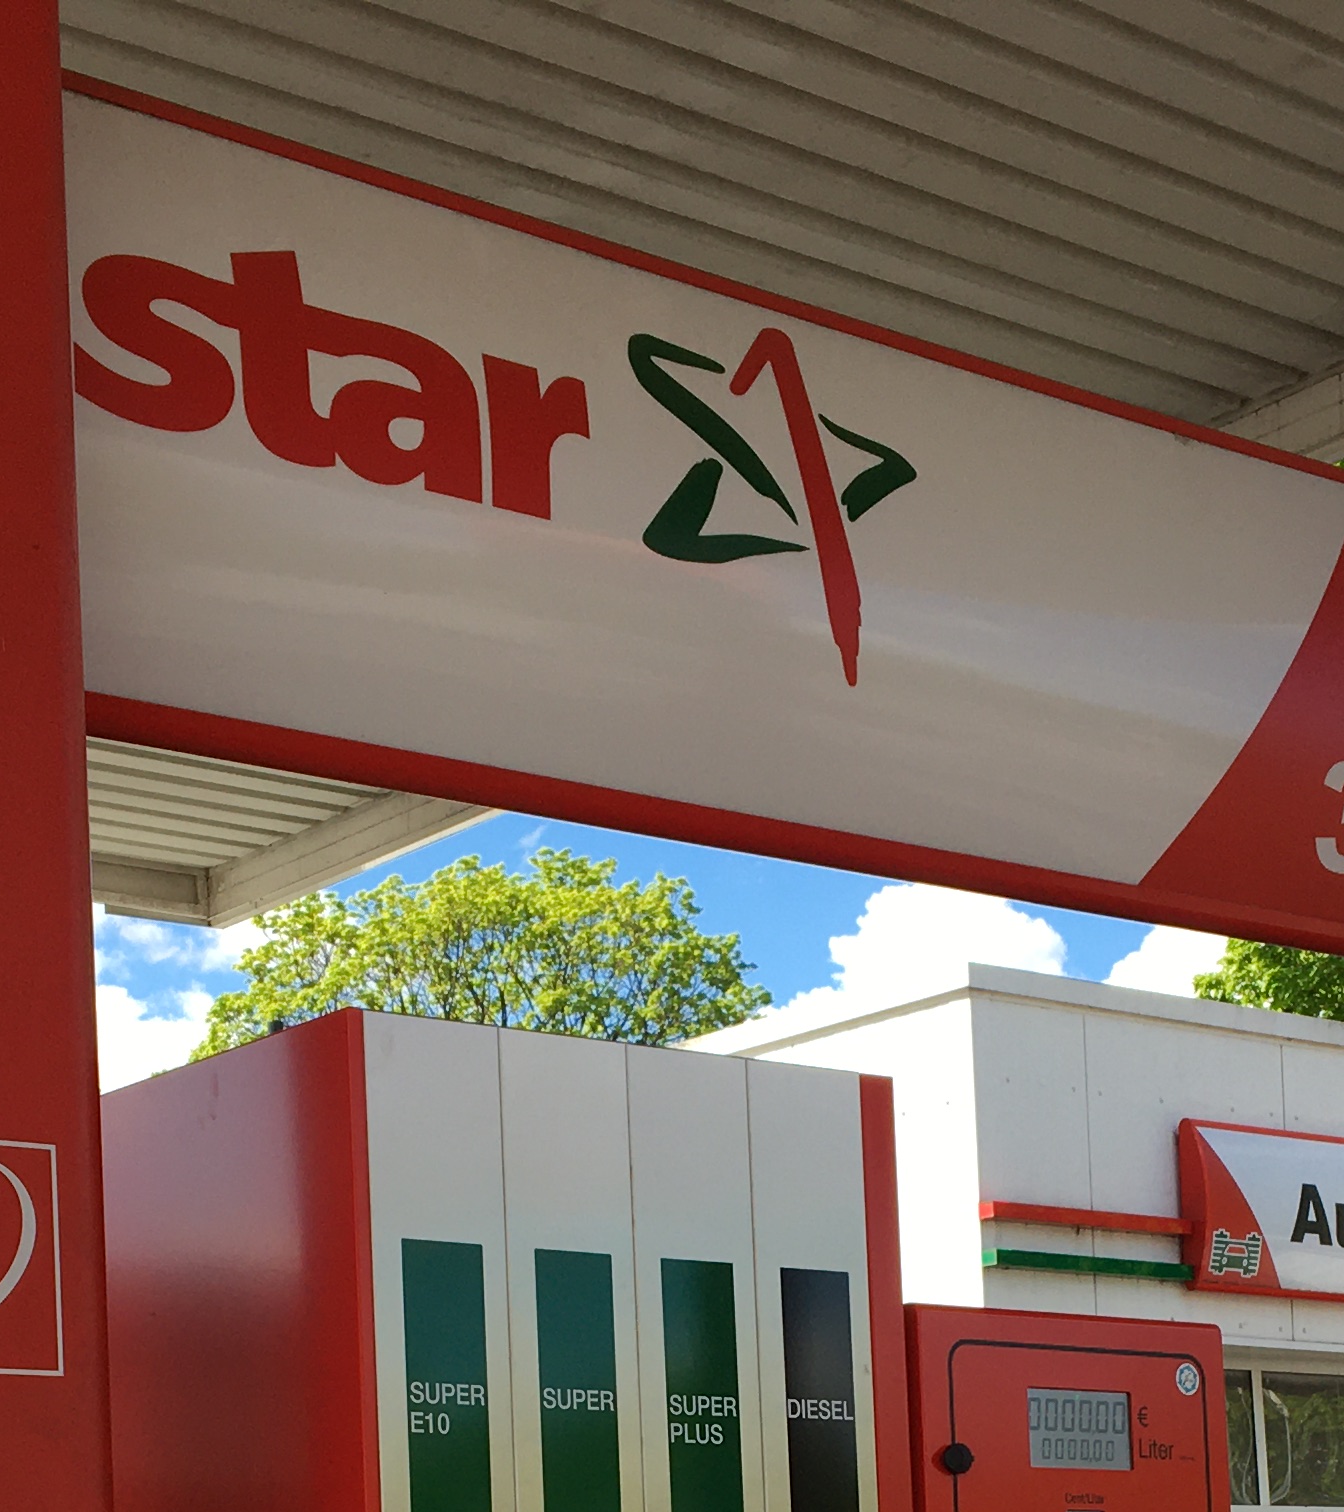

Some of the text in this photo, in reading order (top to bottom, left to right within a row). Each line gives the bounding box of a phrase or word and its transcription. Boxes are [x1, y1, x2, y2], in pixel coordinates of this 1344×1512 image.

[74, 249, 590, 520] star
[409, 1381, 486, 1407] SUPER
[542, 1387, 615, 1413] SUPER
[669, 1395, 738, 1419] SUPER
[787, 1398, 854, 1422] DIESEL
[1136, 1406, 1149, 1428] €
[409, 1410, 451, 1436] E10
[669, 1422, 724, 1445] PLUS
[1138, 1438, 1174, 1460] Liter
